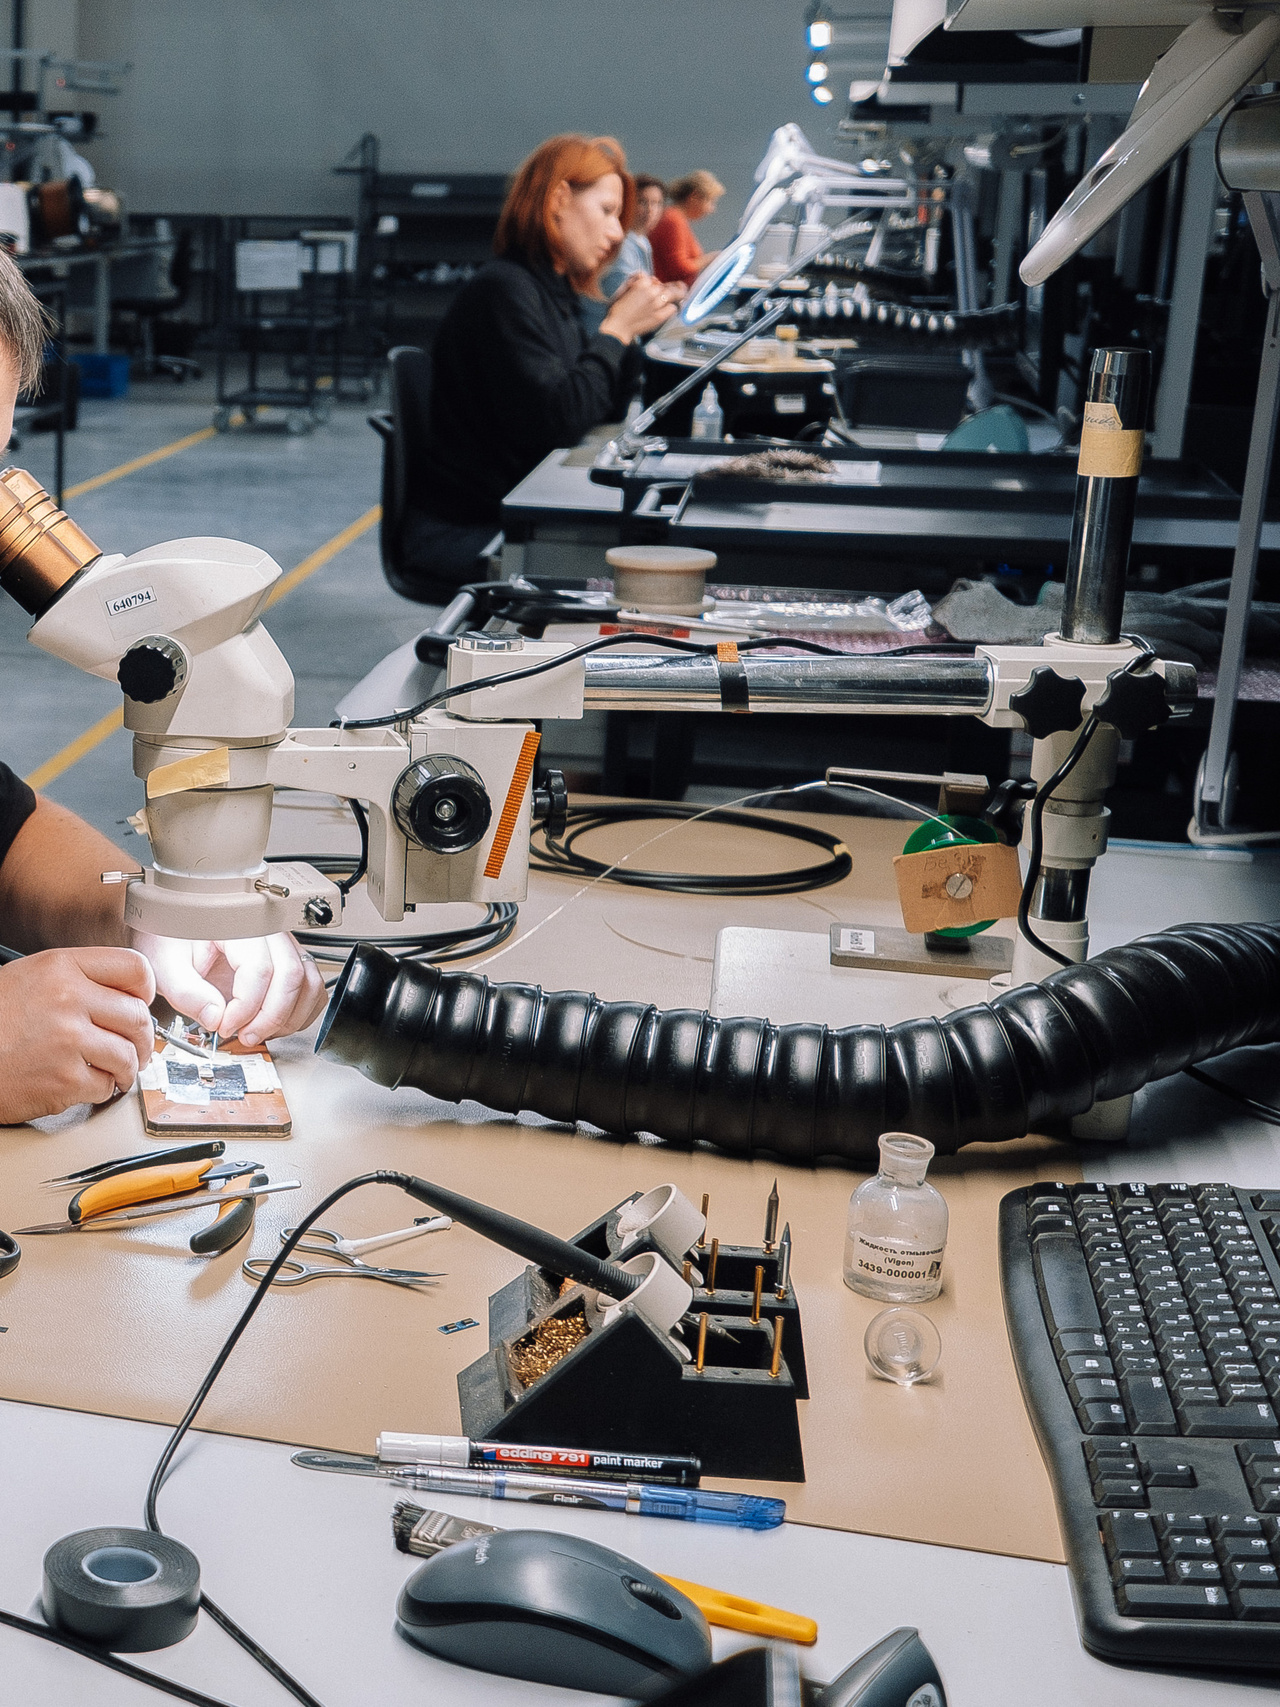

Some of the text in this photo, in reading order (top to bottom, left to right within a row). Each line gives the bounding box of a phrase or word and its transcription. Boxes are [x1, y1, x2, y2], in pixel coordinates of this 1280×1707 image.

[113, 591, 151, 612] 640794
[859, 1237, 897, 1254] Жидкость
[858, 1259, 926, 1279] 3439-000001
[884, 1257, 914, 1267] (Vigon)
[500, 1449, 663, 1469] edding 791 paint marker
[553, 1493, 583, 1504] Flair
